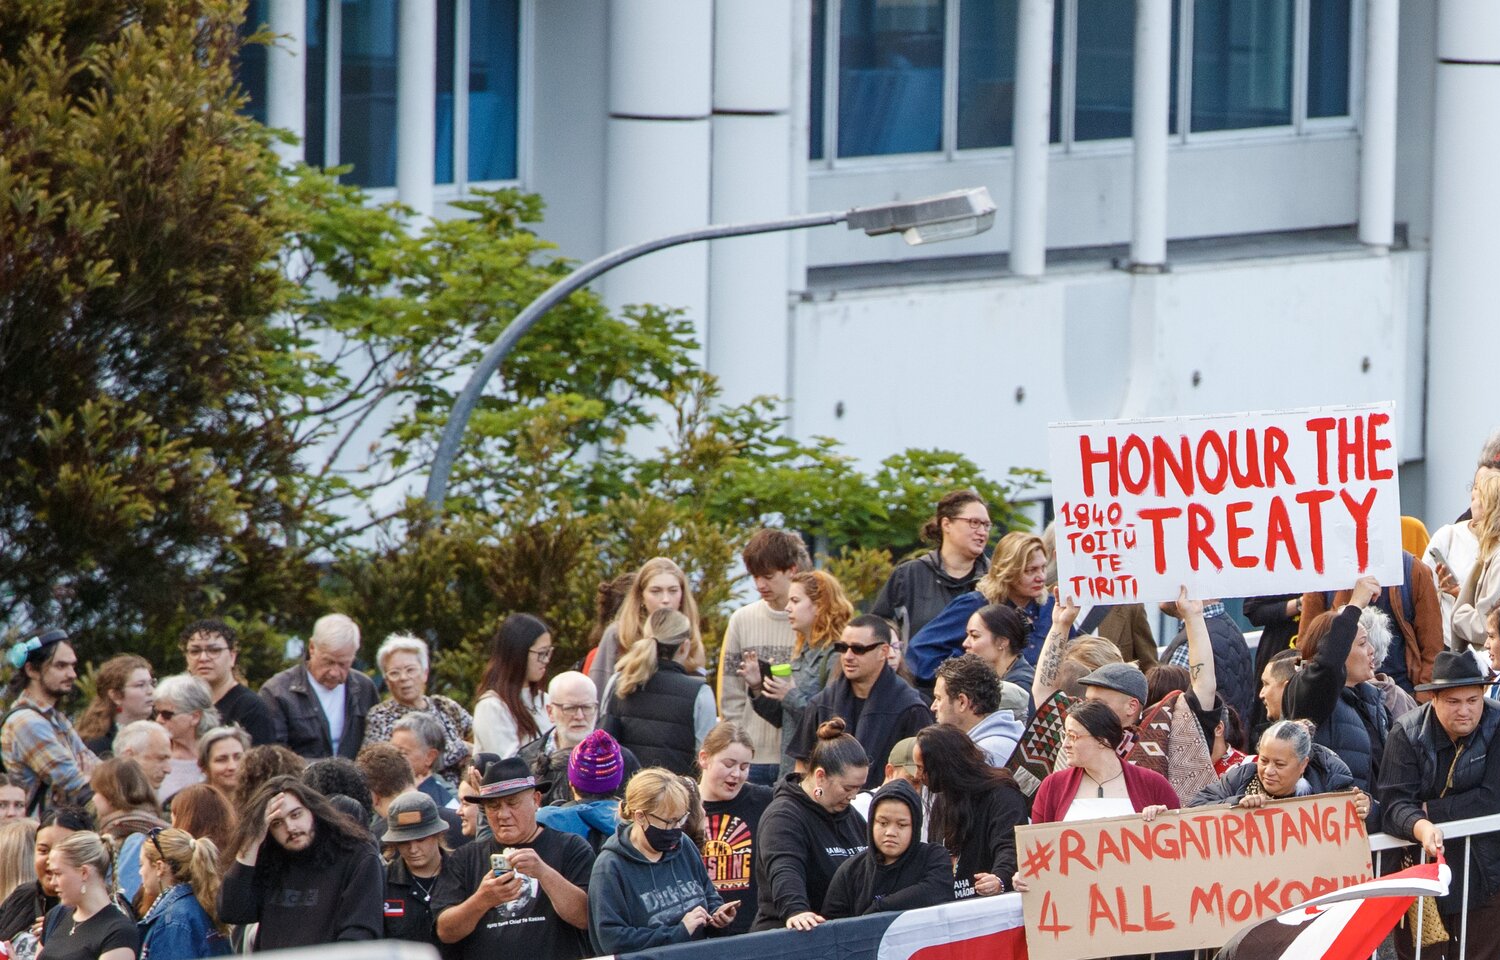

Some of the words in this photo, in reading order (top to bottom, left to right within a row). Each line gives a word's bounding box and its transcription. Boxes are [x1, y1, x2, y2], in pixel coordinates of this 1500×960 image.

[1079, 426, 1295, 498] HONOUR
[1306, 412, 1394, 486] THE
[1060, 501, 1123, 530] 1840
[1136, 487, 1378, 575] TREATY
[1092, 554, 1121, 573] TE
[1069, 575, 1138, 599] TIRITI
[1021, 798, 1366, 880] #RANGATIRATANGA
[704, 854, 751, 880] SHINE
[1037, 890, 1073, 941] 4
[1088, 882, 1175, 936] ALL
